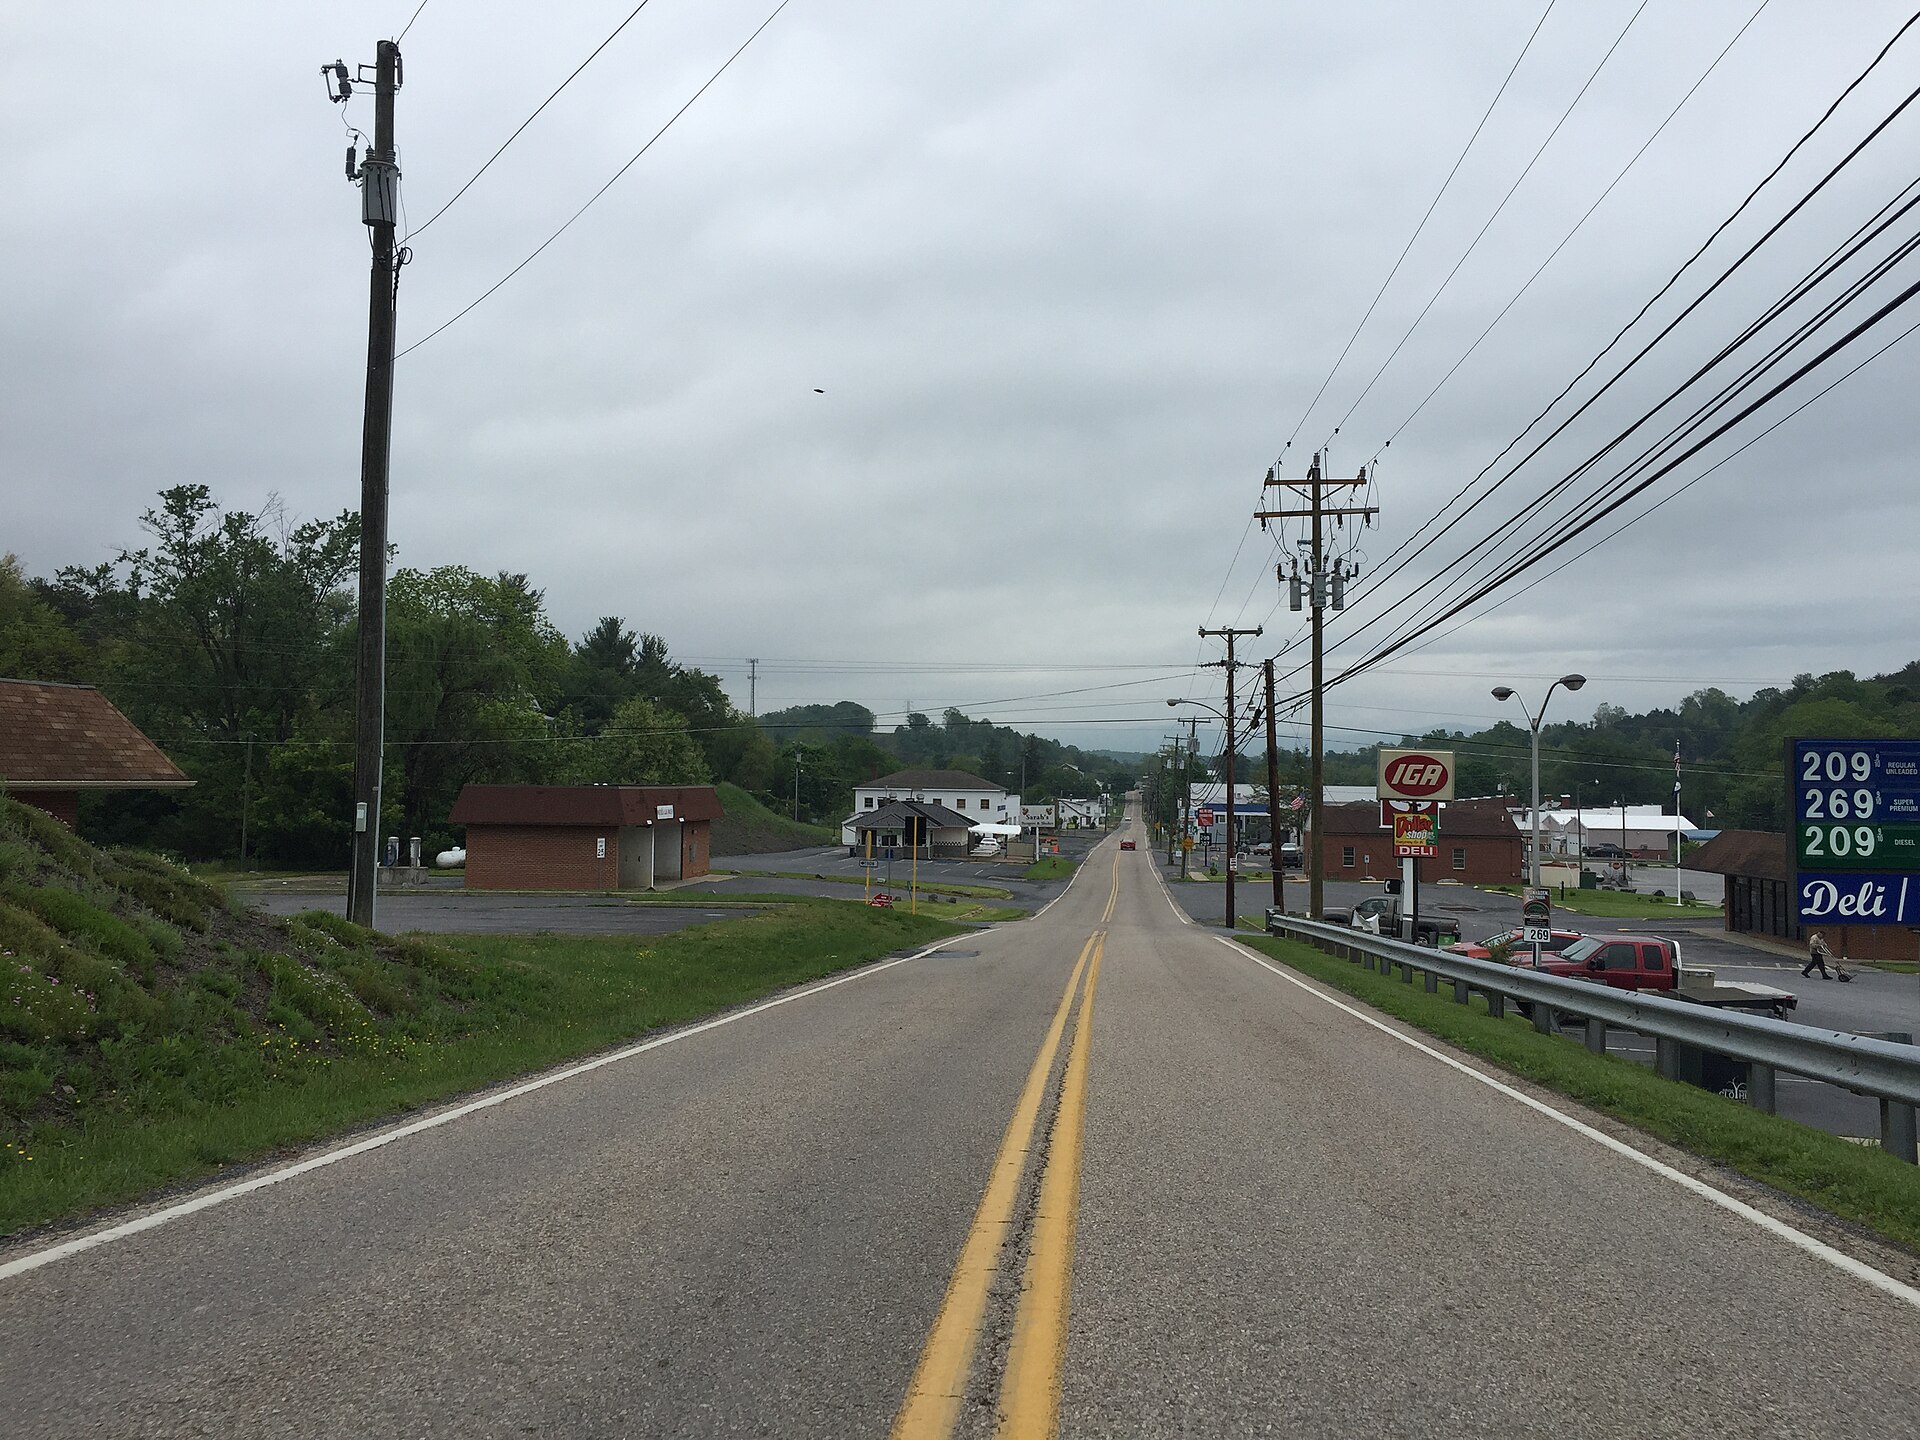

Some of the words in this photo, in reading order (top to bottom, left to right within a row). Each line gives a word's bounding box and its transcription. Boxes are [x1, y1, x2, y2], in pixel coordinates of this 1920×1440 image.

[1803, 751, 1871, 782] 209
[1887, 761, 1916, 769] REGULAR
[1391, 763, 1443, 786] IGA
[1805, 788, 1874, 819] 269
[1893, 798, 1914, 806] SUPER
[1406, 830, 1427, 839] shop
[1805, 825, 1875, 857] 209
[1894, 838, 1916, 846] DIESEL
[1399, 846, 1434, 856] DELI
[1801, 880, 1887, 917] Deli
[1530, 929, 1549, 940] 269
